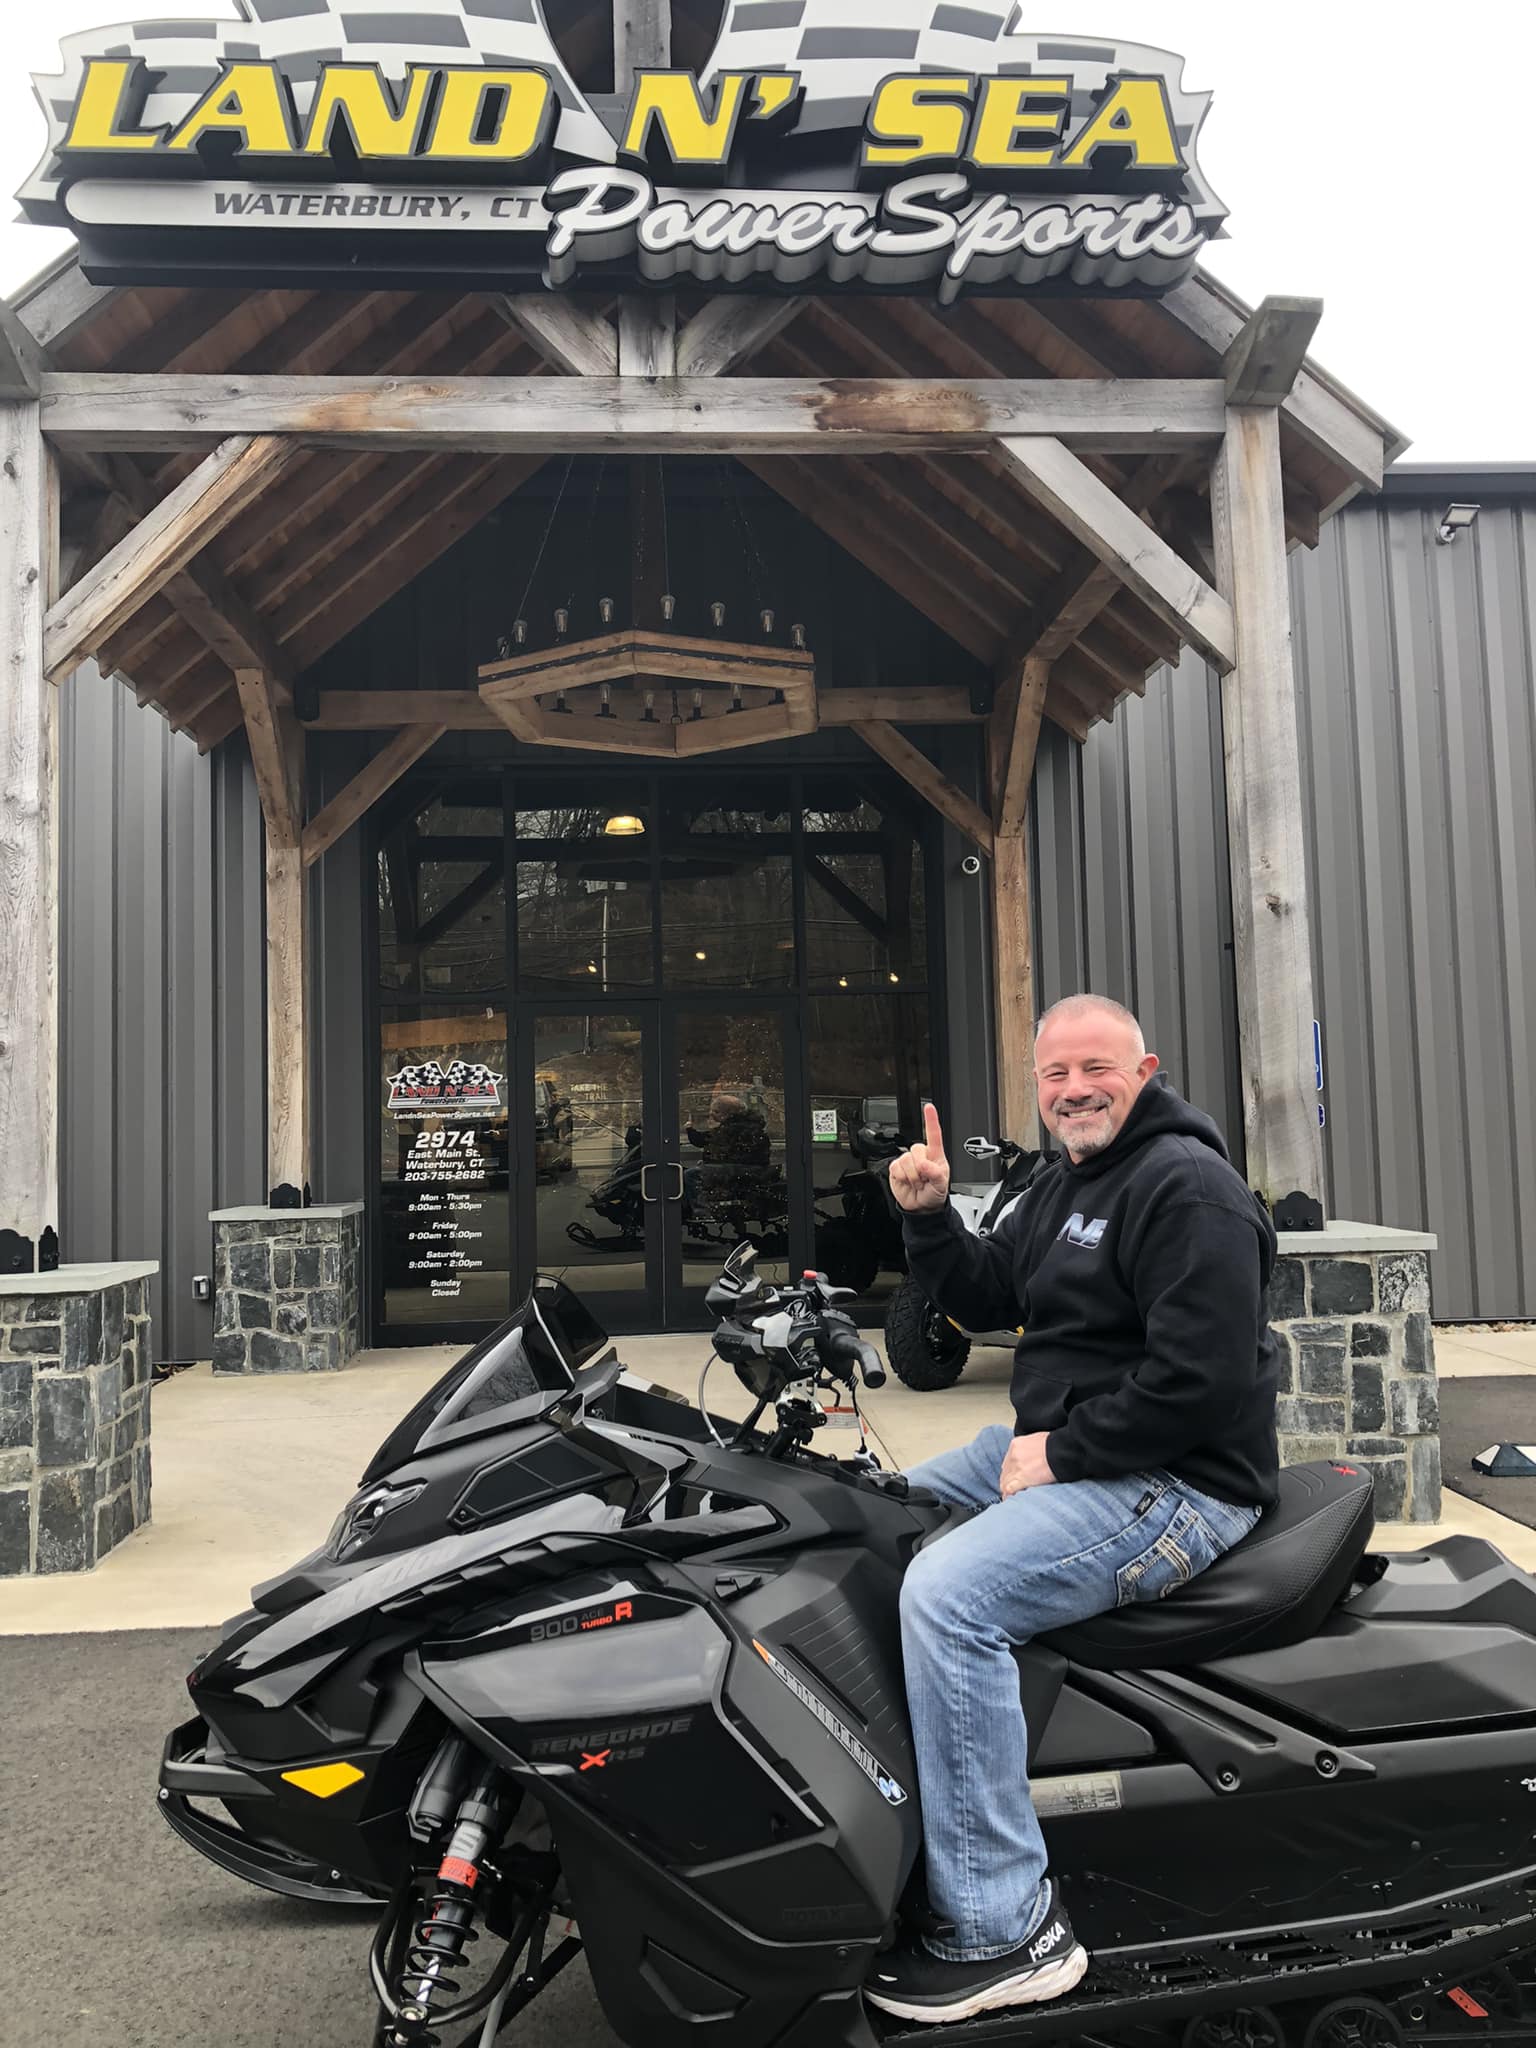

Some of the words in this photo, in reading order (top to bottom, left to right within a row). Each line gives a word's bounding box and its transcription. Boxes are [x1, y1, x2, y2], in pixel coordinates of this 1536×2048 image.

[60, 57, 556, 160] LAND
[624, 69, 800, 165] N'
[860, 73, 1186, 169] SEA
[214, 192, 470, 221] WATERBURY,
[490, 197, 540, 219] CT
[546, 166, 1206, 279] PowerSports
[415, 1131, 475, 1148] 2974
[407, 1150, 432, 1159] East
[435, 1149, 462, 1158] Main
[465, 1148, 481, 1157] St.
[406, 1160, 466, 1170] Waterbury,
[469, 1159, 485, 1168] CT
[404, 1170, 486, 1181] 203-755-2682
[408, 1203, 441, 1211] 9:00am
[449, 1202, 482, 1211] 5:30pm
[432, 1222, 459, 1230] Friday
[449, 1231, 482, 1239] 5:00pm
[426, 1250, 465, 1259] Saturday
[408, 1261, 442, 1269] 9:00am
[449, 1259, 482, 1268] 2:00pm
[430, 1280, 461, 1288] Sunday
[431, 1289, 461, 1297] Closed
[615, 1601, 632, 1621] R
[581, 1616, 613, 1629] TURBO
[531, 1617, 578, 1642] 900
[531, 1716, 693, 1755] RENEGADE
[1028, 1921, 1066, 1963] HOKA
